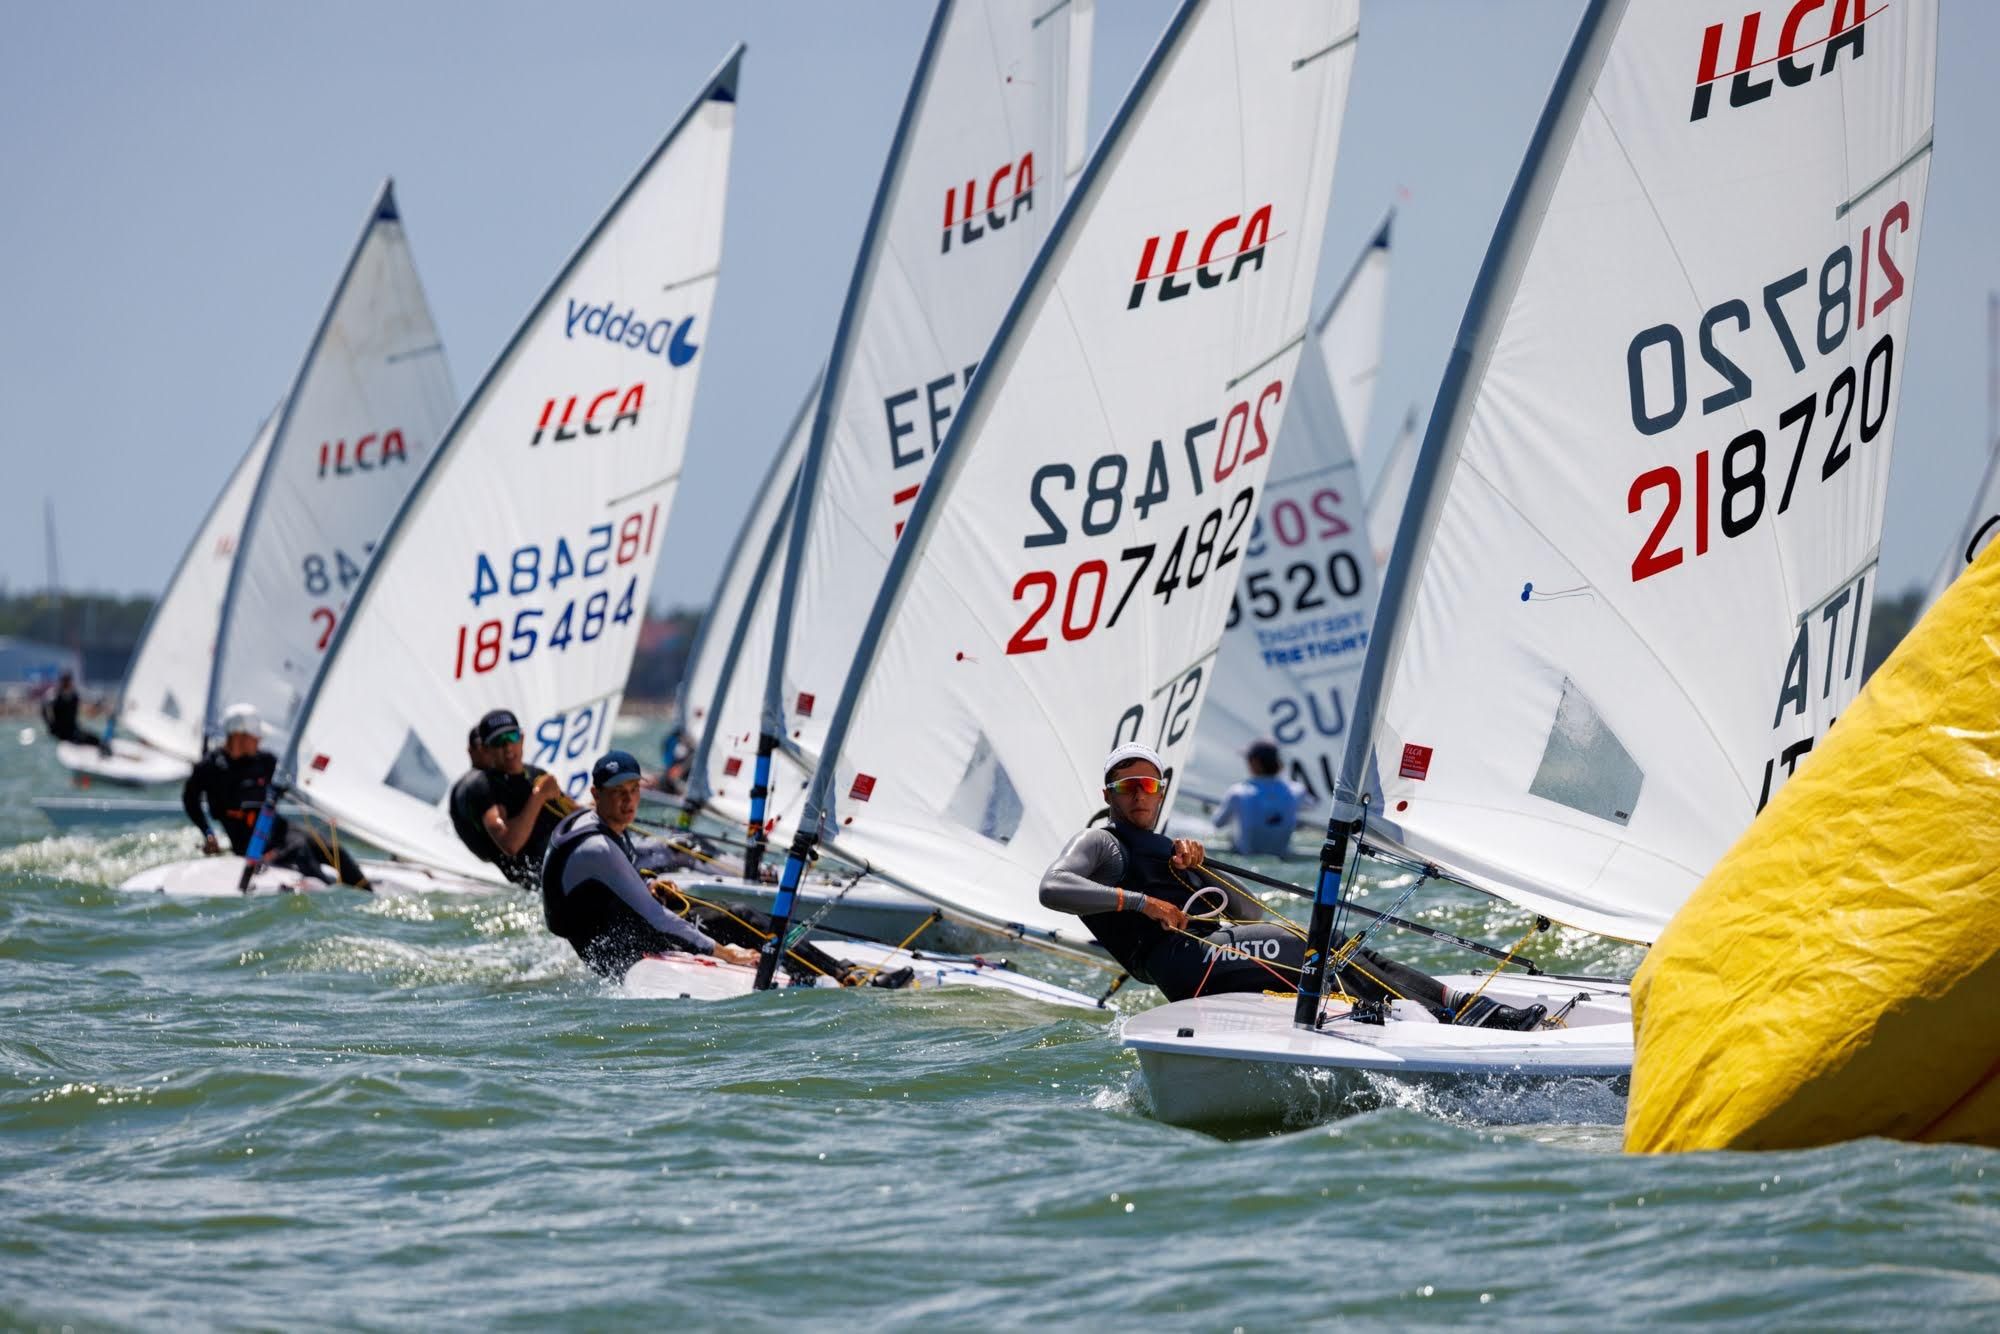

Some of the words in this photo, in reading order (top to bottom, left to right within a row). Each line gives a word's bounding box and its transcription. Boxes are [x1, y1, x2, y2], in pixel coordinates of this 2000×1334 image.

[1690, 0, 1866, 122] ILCA
[941, 151, 1034, 255] ILCA
[1127, 204, 1272, 310] ILCA
[318, 428, 407, 479] ILCA
[531, 383, 646, 446] ILCA
[884, 362, 979, 469] EE
[1628, 334, 1894, 582] 218720
[1006, 486, 1254, 655] 207482
[455, 574, 637, 680] 185484
[1203, 939, 1280, 963] MUSTO
